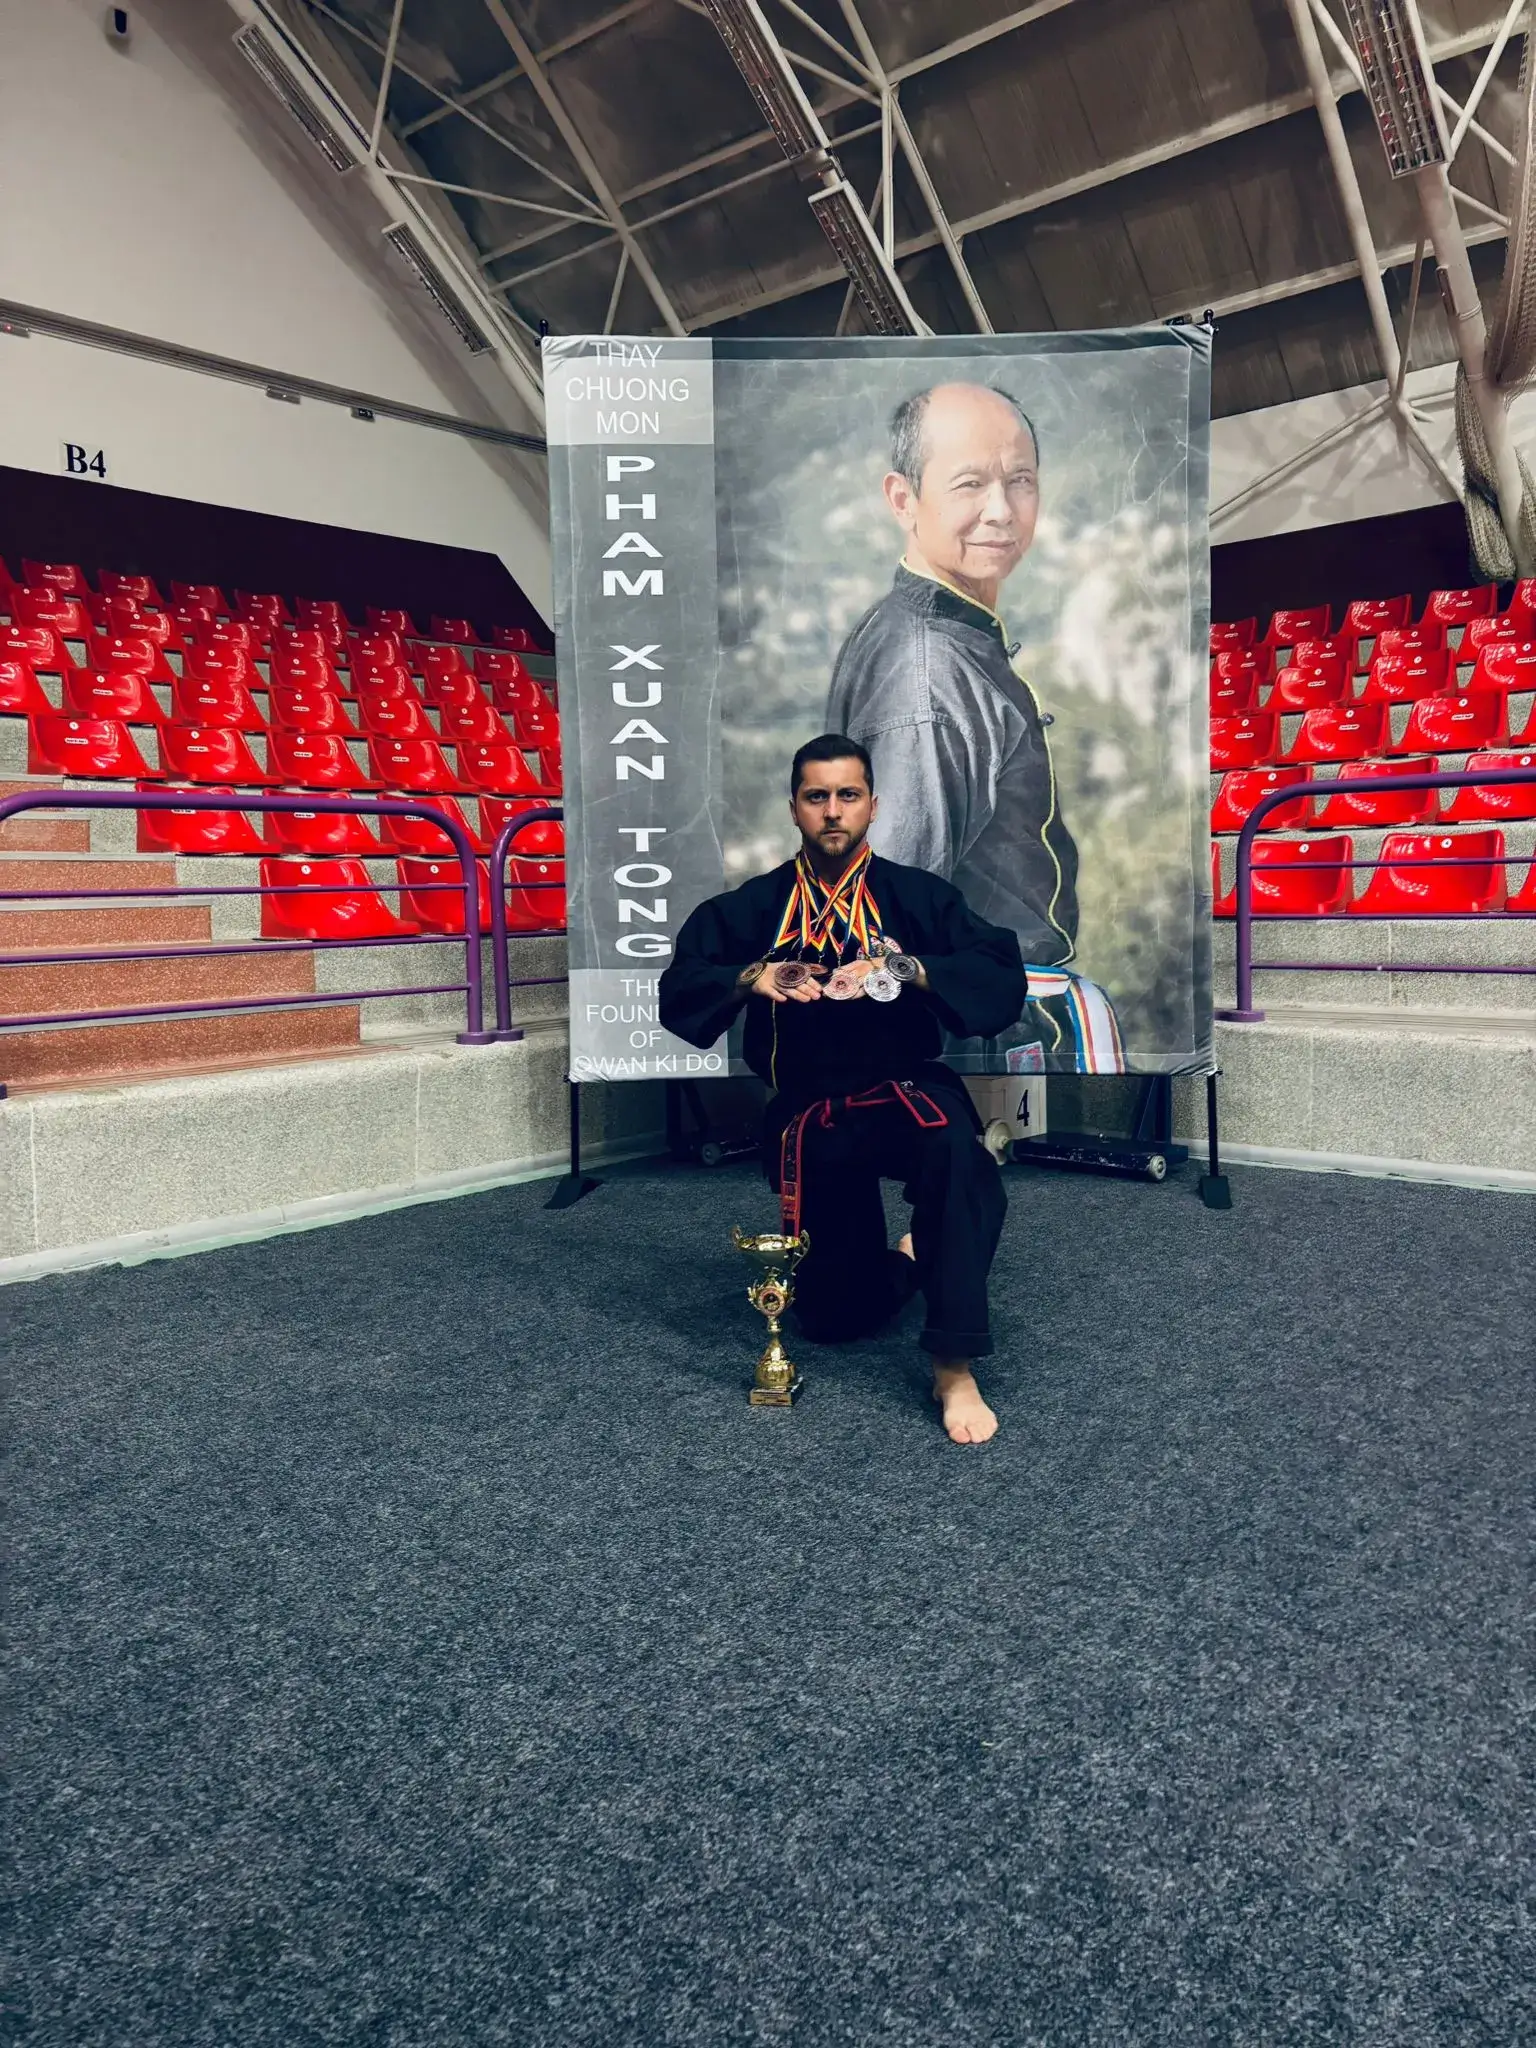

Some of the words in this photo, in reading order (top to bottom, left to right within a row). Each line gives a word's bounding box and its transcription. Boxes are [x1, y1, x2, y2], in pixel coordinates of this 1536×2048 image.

[589, 341, 663, 368] THAY
[566, 376, 690, 402] CHUONG
[597, 410, 660, 435] MON
[64, 442, 107, 478] B4
[602, 455, 664, 596] PHAM
[609, 644, 669, 780] XUAN
[613, 827, 673, 958] TONG
[629, 1029, 663, 1049] OF
[655, 1054, 677, 1073] KI
[686, 1053, 722, 1072] DO
[1016, 1089, 1030, 1127] 4
